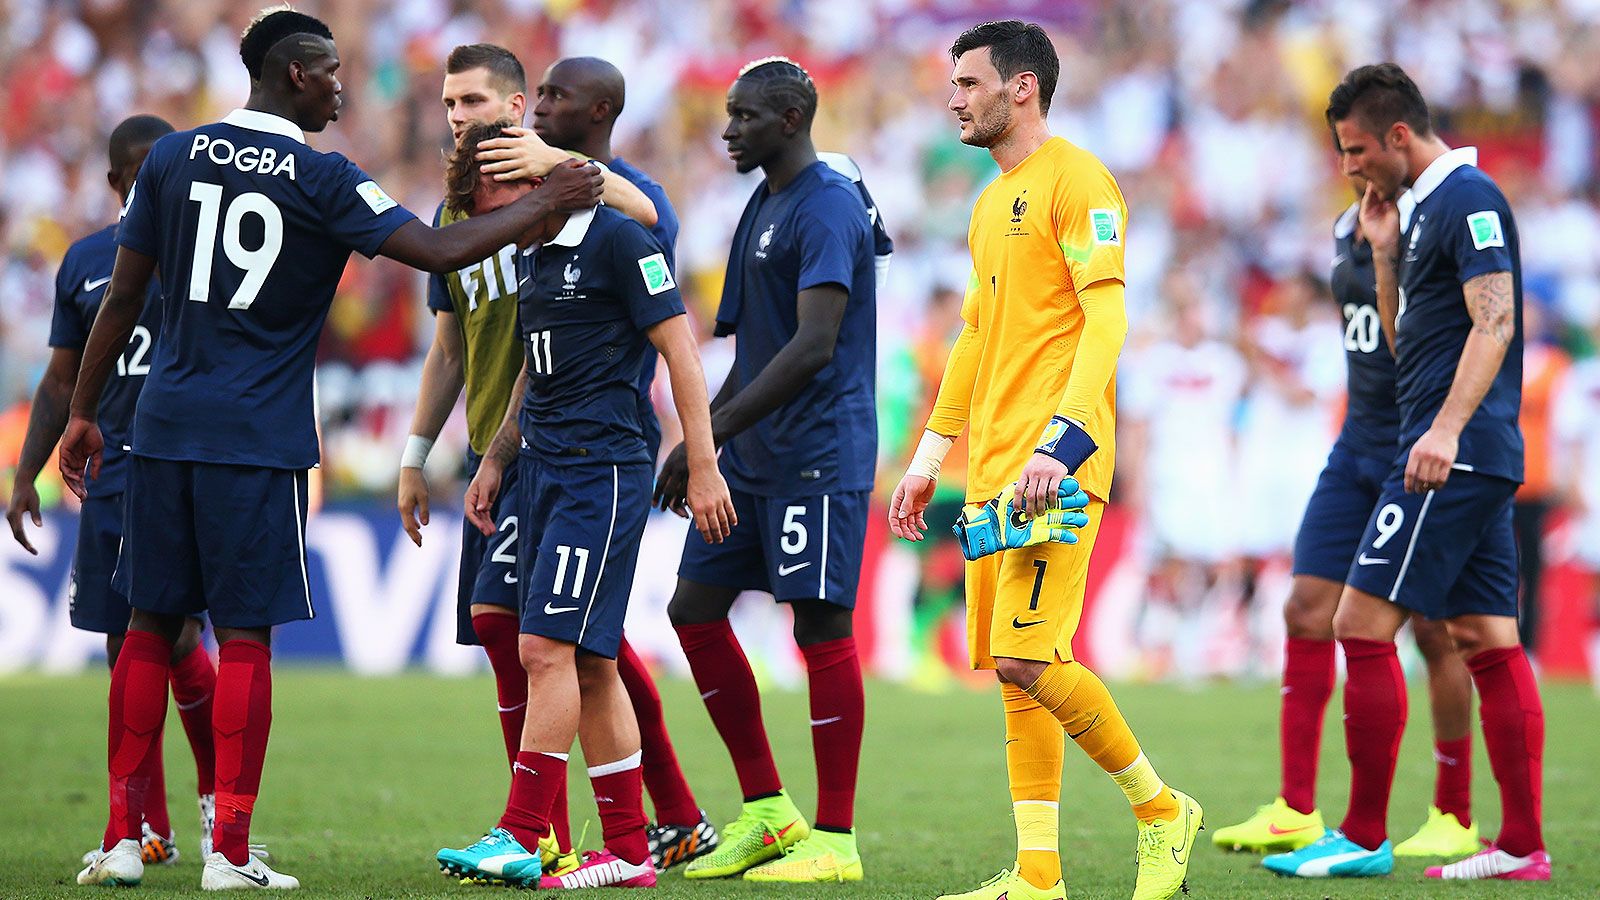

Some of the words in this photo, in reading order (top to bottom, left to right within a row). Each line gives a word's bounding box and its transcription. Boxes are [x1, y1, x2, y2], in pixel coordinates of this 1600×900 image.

[189, 134, 296, 181] POGBA
[188, 180, 284, 310] 19
[457, 243, 518, 313] FIF
[530, 330, 552, 375] 11
[1343, 302, 1380, 353] 20
[780, 505, 808, 555] 5
[1372, 503, 1405, 549] 9
[552, 545, 590, 599] 11
[1029, 559, 1048, 611] 1
